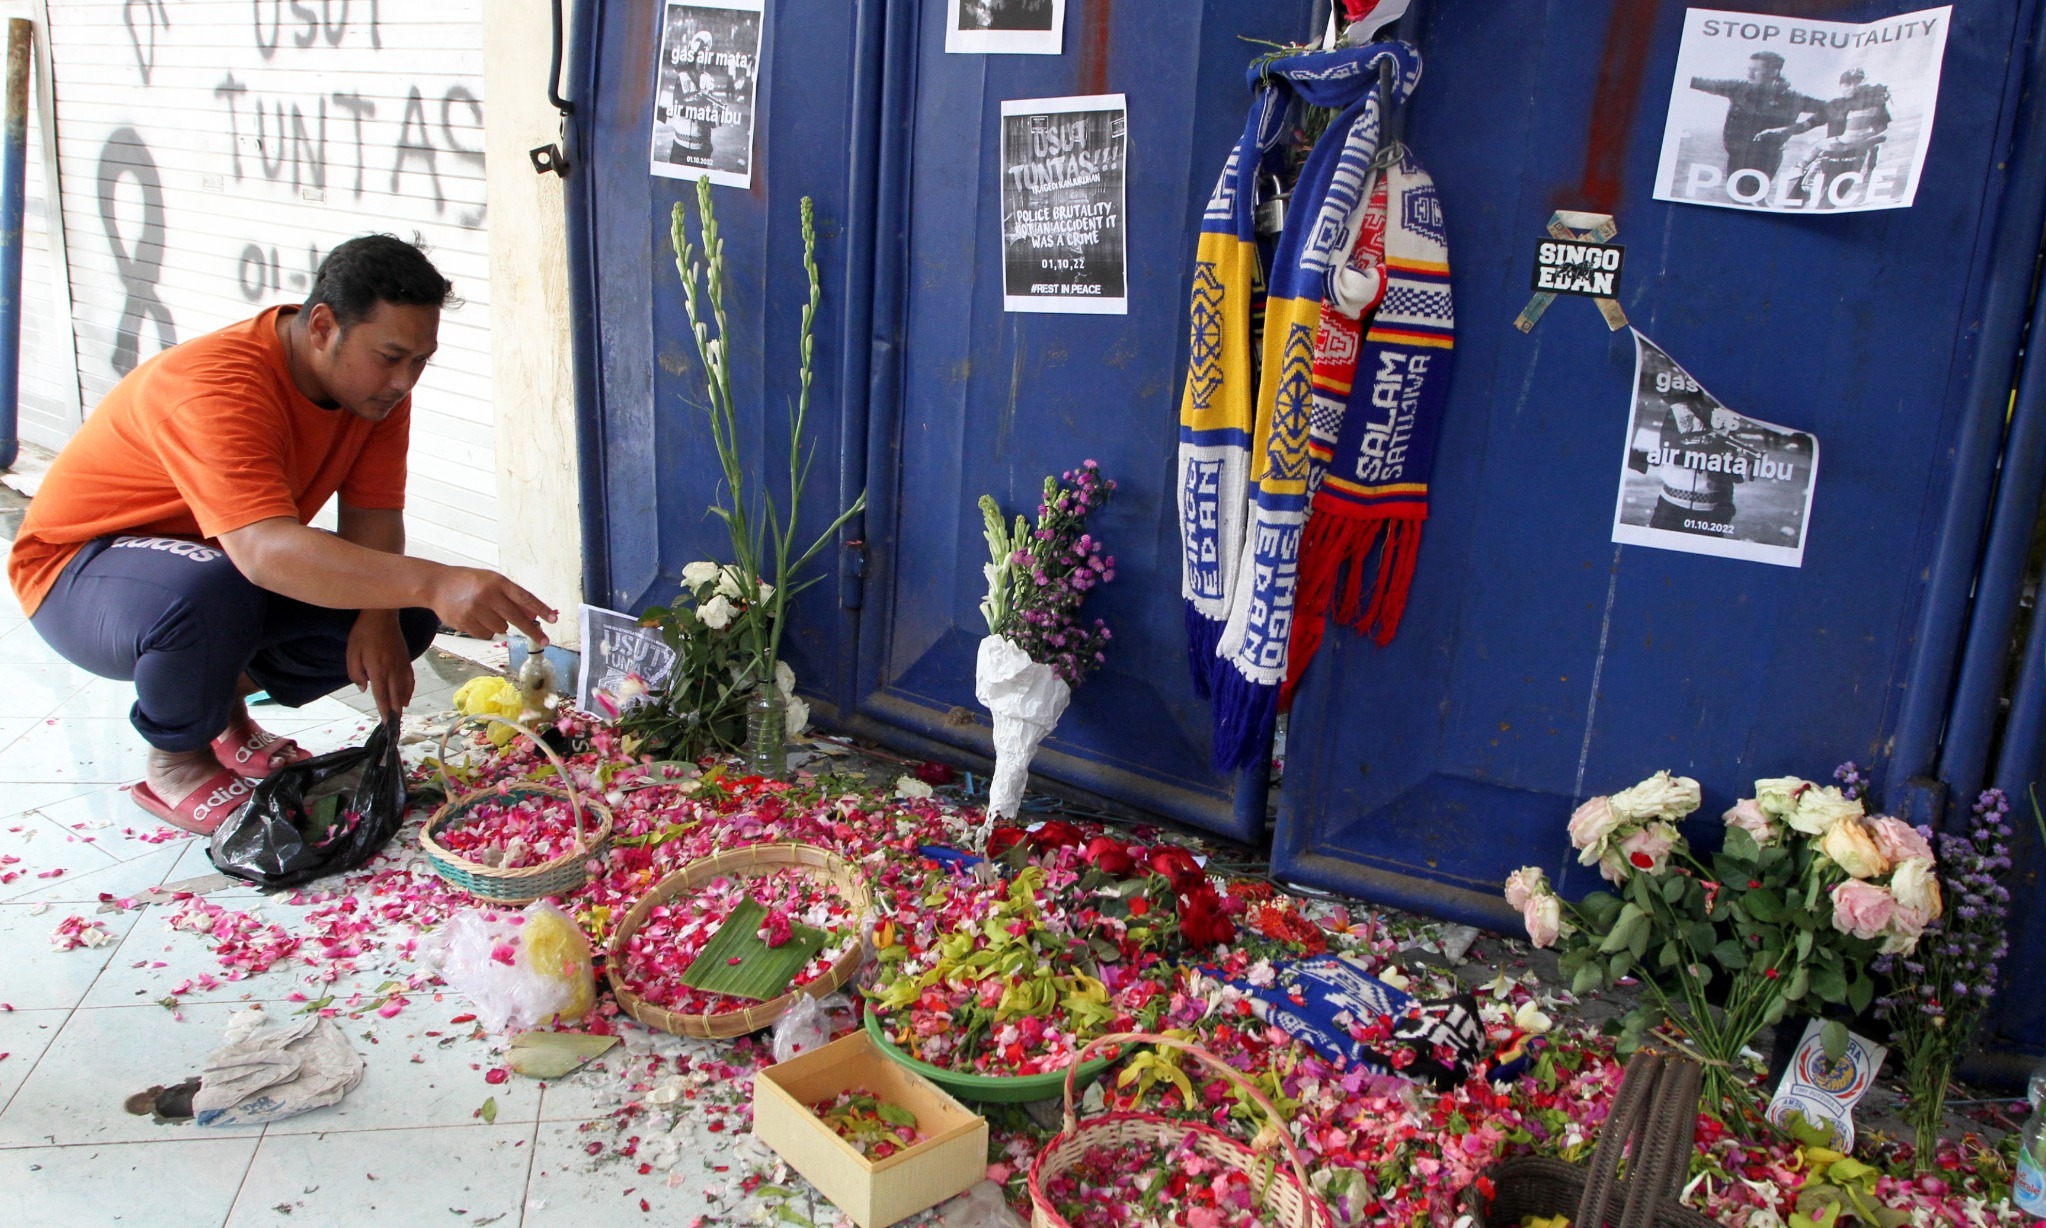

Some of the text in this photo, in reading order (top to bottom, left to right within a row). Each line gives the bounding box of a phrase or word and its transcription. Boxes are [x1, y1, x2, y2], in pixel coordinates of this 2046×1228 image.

[1702, 17, 1937, 49] STOP BRUTALITY
[671, 48, 748, 68] gas air mata
[666, 100, 742, 126] air mata ibu
[214, 73, 488, 226] TUNTAS
[686, 155, 714, 166] 01.10.2022
[1685, 163, 1898, 209] POLICE
[1016, 202, 1112, 223] POLICE BRUTALITY
[1053, 216, 1103, 235] ACCIDENT
[1105, 214, 1117, 229] IT
[1031, 230, 1099, 249] WAS A CRIME
[1538, 242, 1620, 271] SINGO
[1030, 283, 1102, 295] #REST IN PEACE
[1537, 265, 1615, 295] EDAN
[1655, 371, 1699, 393] gas
[1355, 350, 1408, 482] SALAM
[1647, 442, 1793, 481] air mata ibu
[1197, 467, 1219, 596] EDAN
[1683, 518, 1735, 534] 01.10.2022
[1243, 528, 1280, 665] EDAN
[1262, 527, 1300, 668] SINGO
